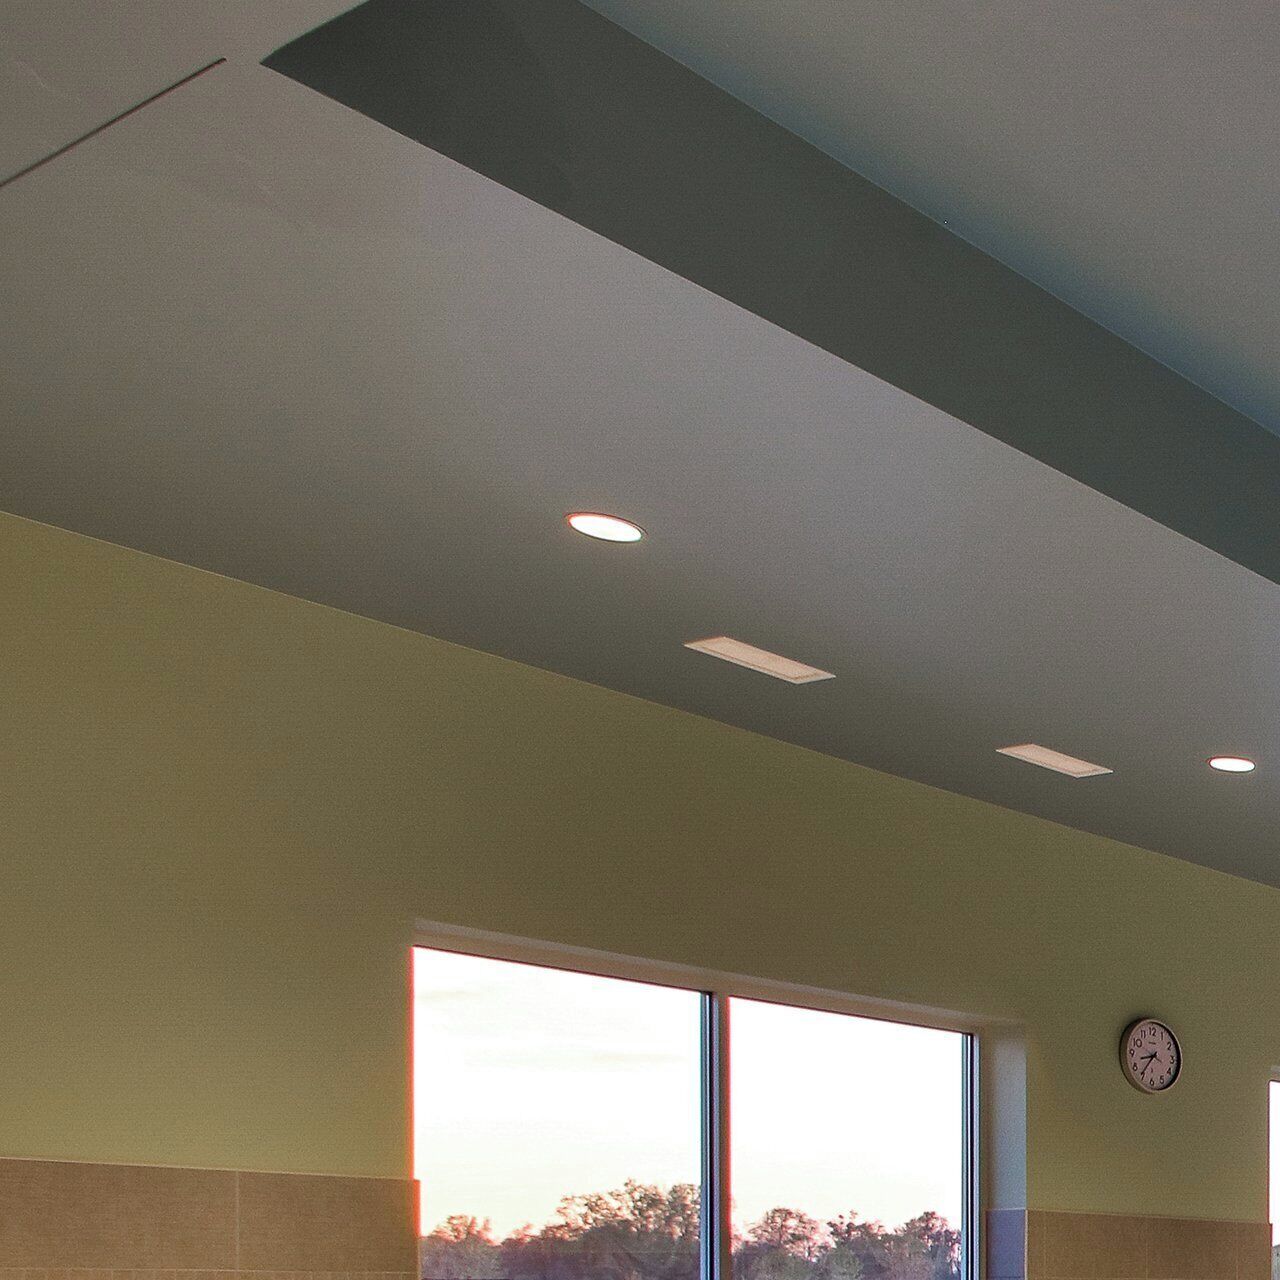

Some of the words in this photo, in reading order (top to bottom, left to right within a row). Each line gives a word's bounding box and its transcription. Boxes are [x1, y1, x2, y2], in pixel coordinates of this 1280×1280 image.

[1141, 1029, 1146, 1039] 11
[1149, 1027, 1157, 1037] 12
[1133, 1038, 1142, 1048] 10
